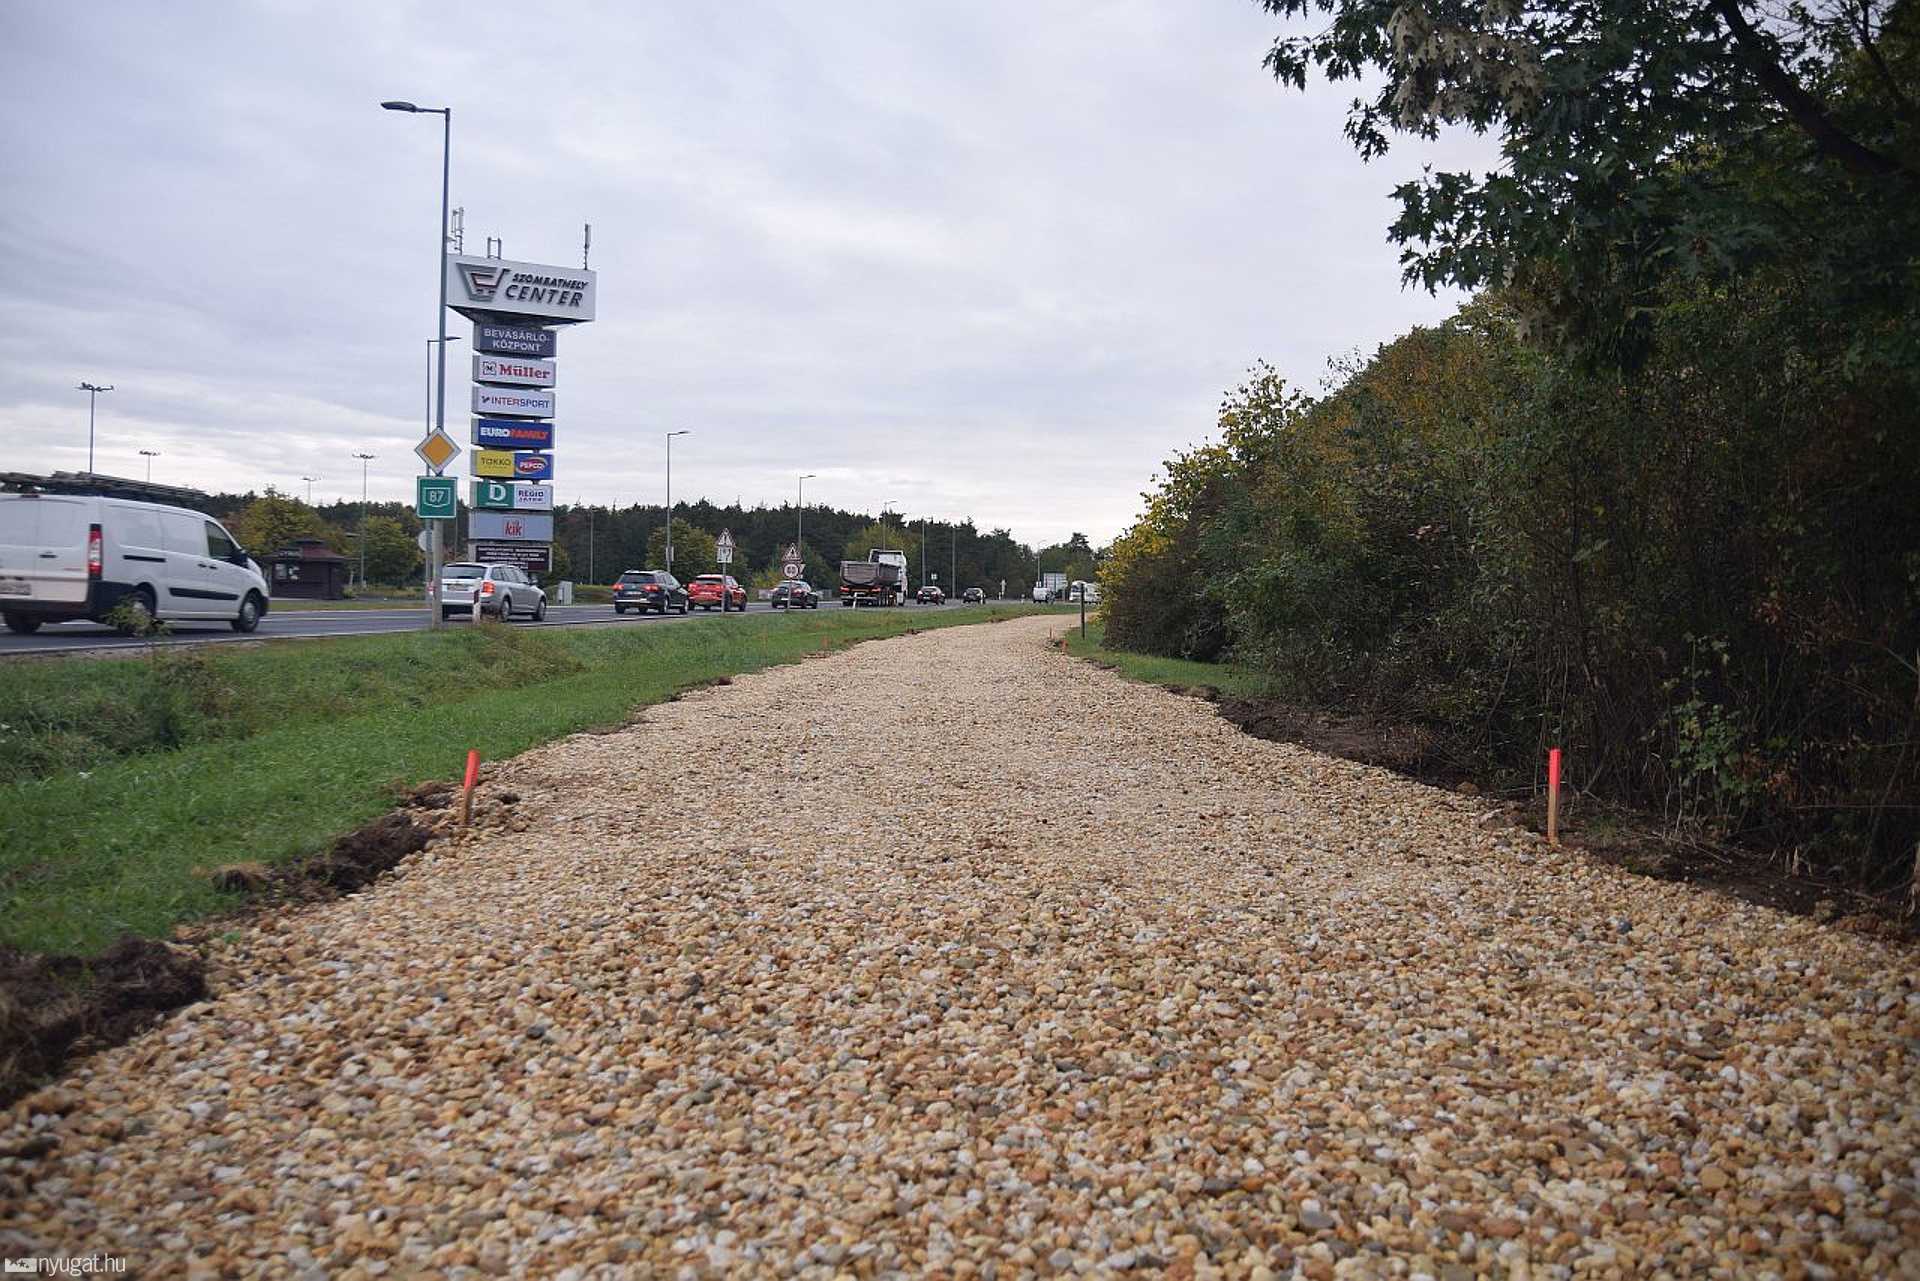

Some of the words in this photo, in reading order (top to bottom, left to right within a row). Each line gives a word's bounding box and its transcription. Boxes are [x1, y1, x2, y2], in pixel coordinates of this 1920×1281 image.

[512, 273, 589, 290] SZOMBATHELY
[505, 284, 583, 307] CENTER
[499, 363, 550, 379] Müller
[491, 396, 550, 409] INTERSPORT
[429, 490, 444, 503] 87
[489, 484, 506, 501] D
